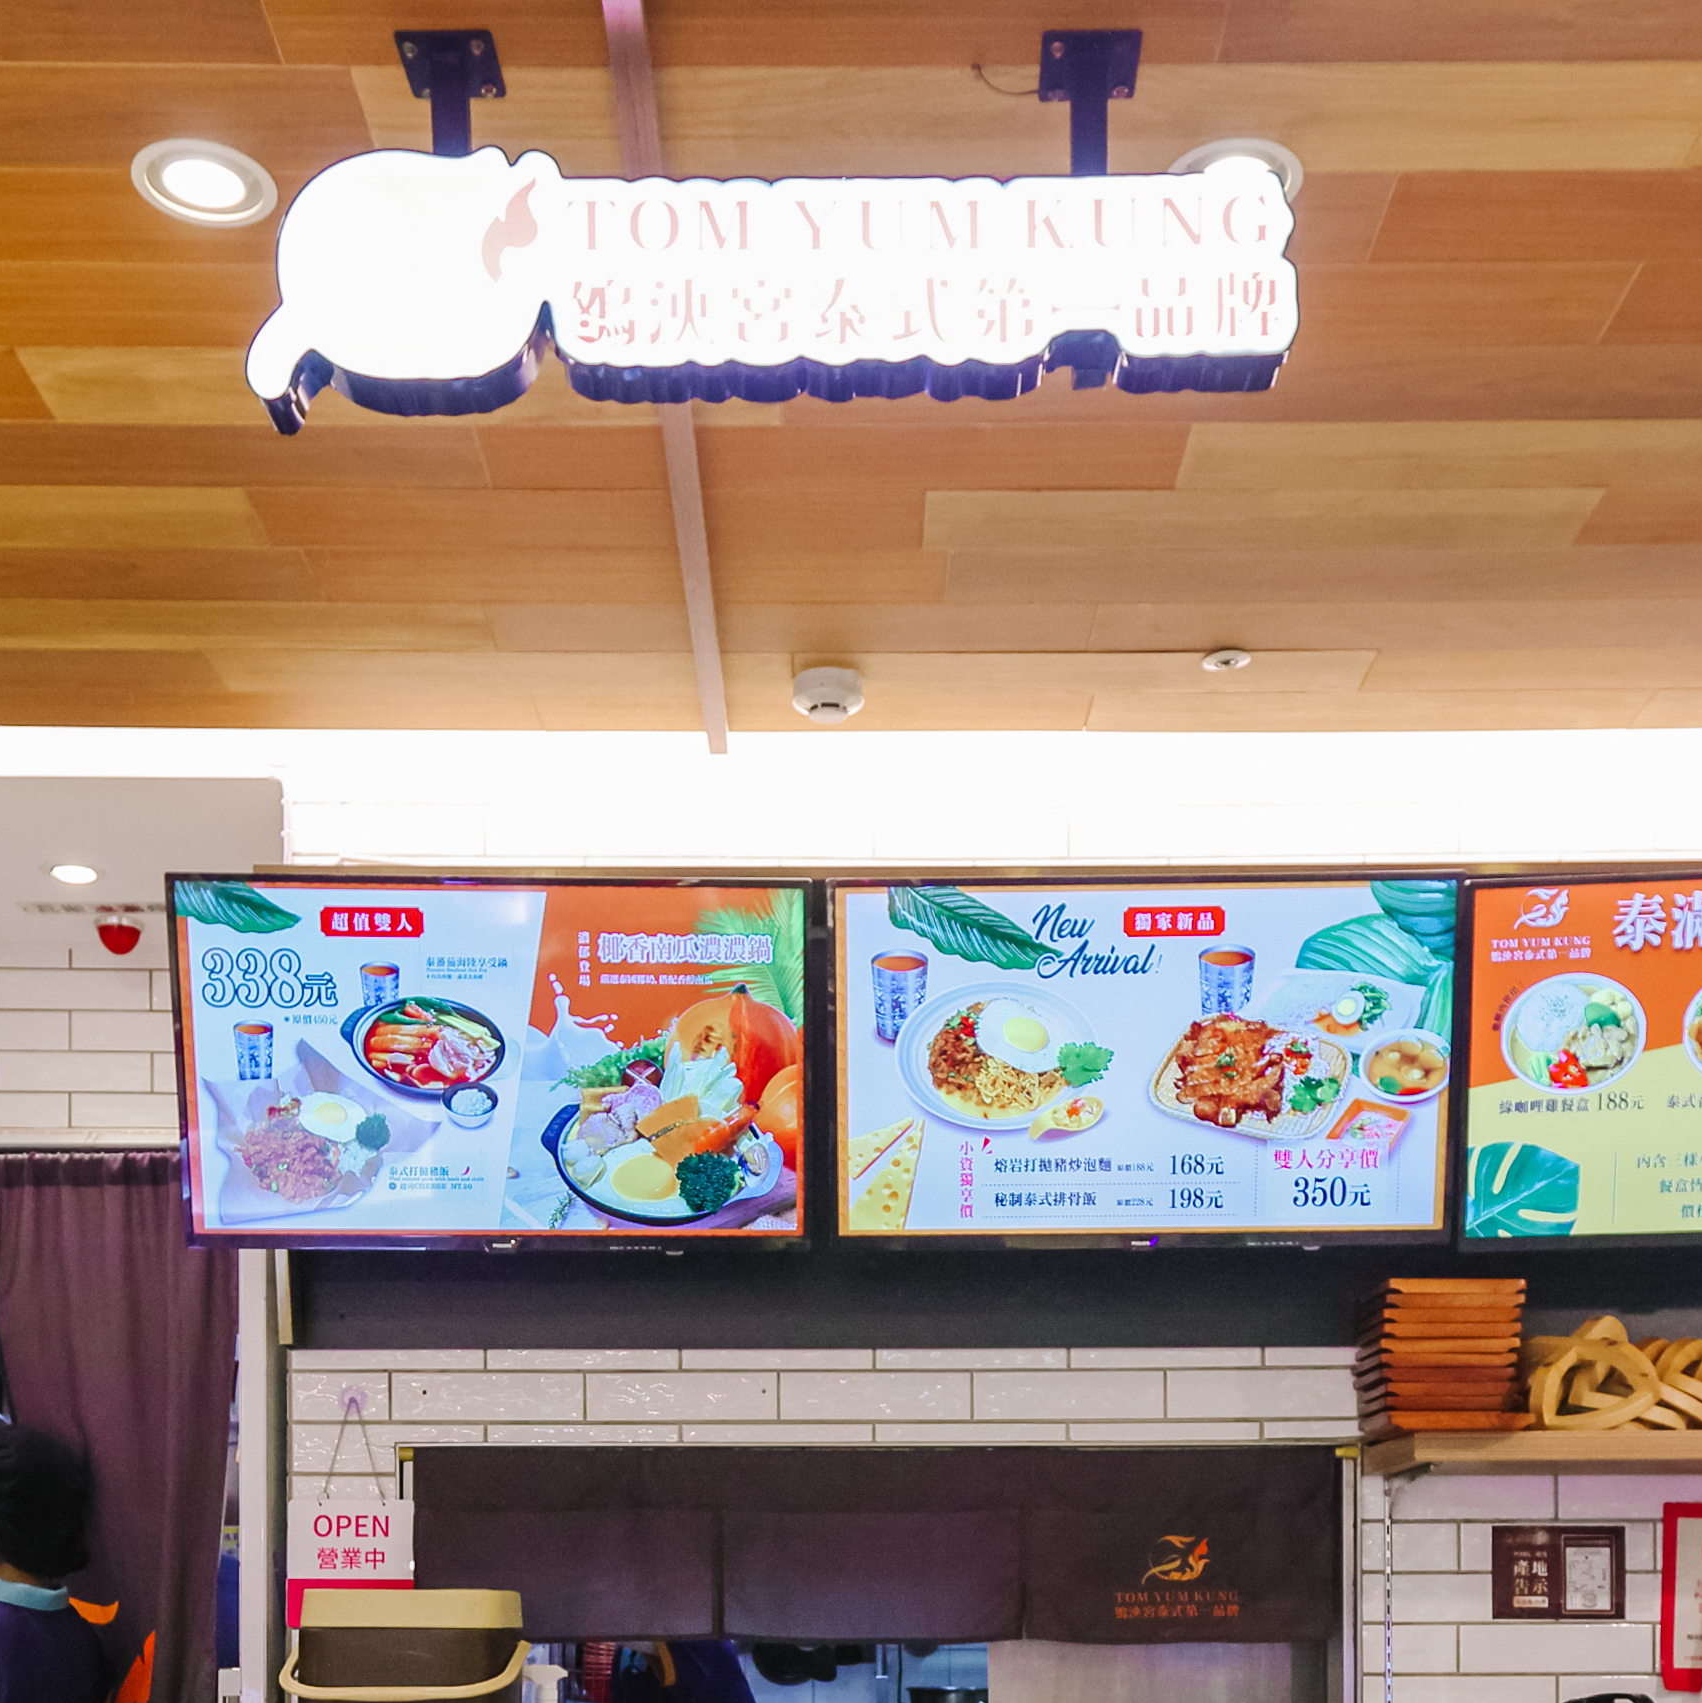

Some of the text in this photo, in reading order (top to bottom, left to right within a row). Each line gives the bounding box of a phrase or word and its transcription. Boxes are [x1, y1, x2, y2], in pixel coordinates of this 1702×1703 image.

[568, 192, 1269, 251] TOM YUM KUNG
[331, 911, 414, 933] 超值雙人
[1032, 902, 1096, 943] New
[1134, 911, 1215, 932] 獨家新品
[596, 931, 775, 964] 椰香南瓜濃濃鍋
[1491, 938, 1519, 949] TOM
[1036, 939, 1164, 979] Arrival!
[201, 947, 339, 1009] 338元
[1596, 1091, 1646, 1112] 188元
[1168, 1153, 1225, 1176] 168元
[1273, 1147, 1380, 1171] 雙人分享價
[959, 1140, 975, 1219] 小資獨享價
[1292, 1175, 1373, 1208] 350元
[1168, 1187, 1225, 1210] 198元
[313, 1514, 391, 1538] OPEN
[316, 1547, 387, 1570] 營業中
[1115, 1591, 1239, 1603] TOM YUM KUNG
